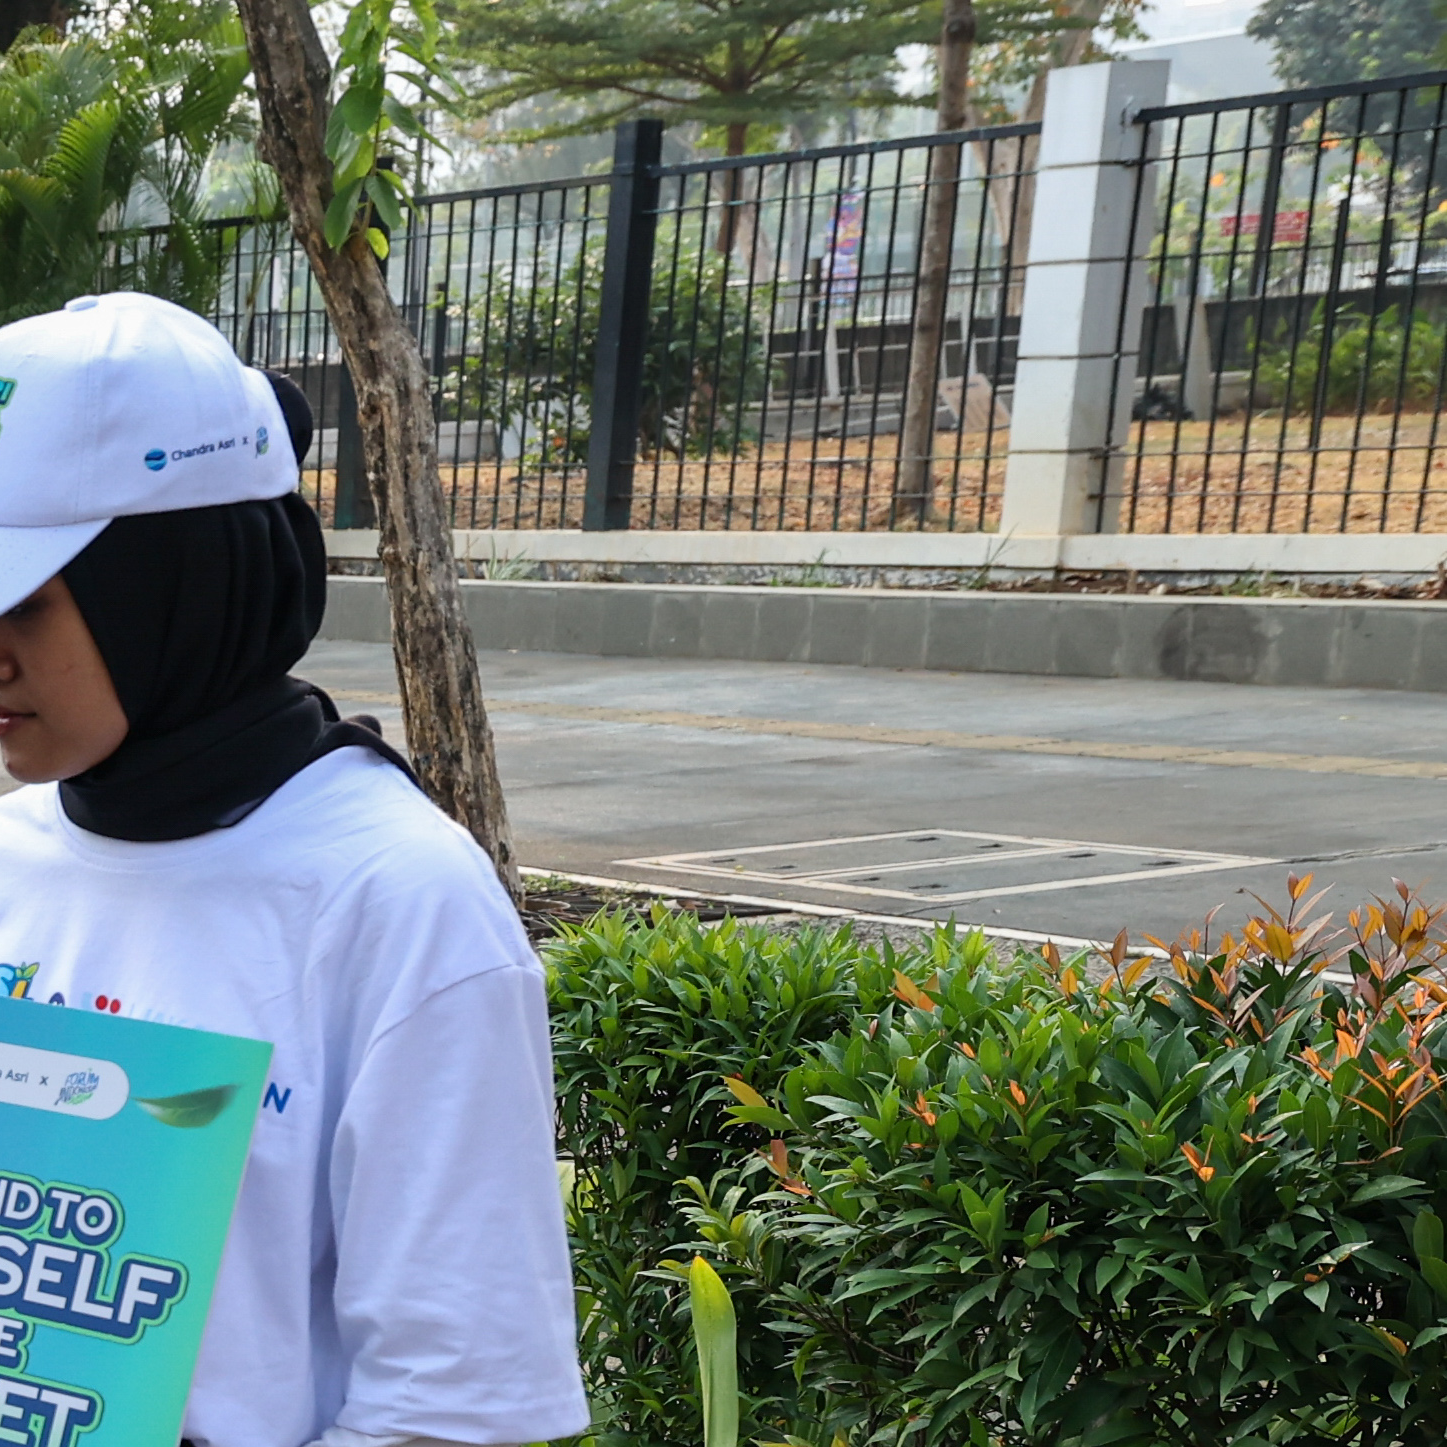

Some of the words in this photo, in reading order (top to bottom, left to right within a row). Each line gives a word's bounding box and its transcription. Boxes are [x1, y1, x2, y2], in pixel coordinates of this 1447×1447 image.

[171, 444, 215, 461] Chandra
[218, 438, 236, 450] Asri
[5, 1069, 30, 1083] Asri
[48, 1190, 114, 1237] TO
